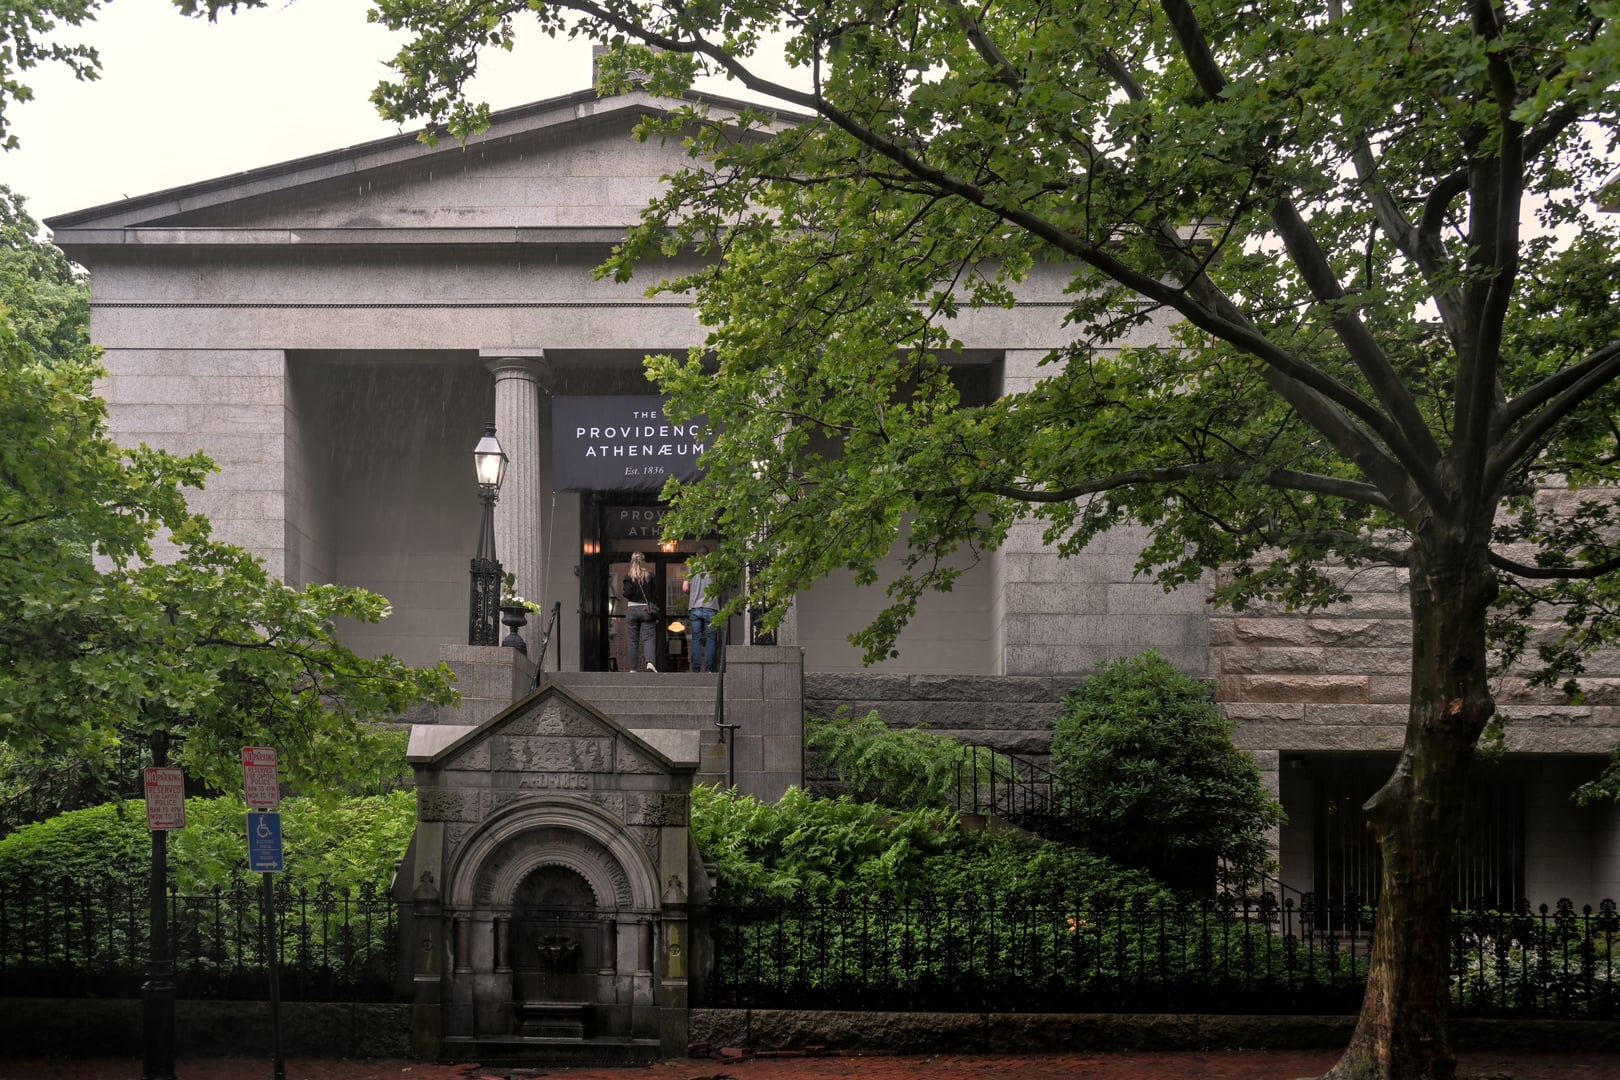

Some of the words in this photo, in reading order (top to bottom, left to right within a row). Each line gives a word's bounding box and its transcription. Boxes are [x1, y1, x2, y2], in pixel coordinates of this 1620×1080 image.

[633, 411, 657, 419] THE
[625, 467, 640, 475] Est.
[643, 466, 665, 475] 1836
[245, 751, 253, 762] NO
[254, 753, 275, 761] PARKING
[147, 772, 157, 783] NO
[158, 774, 181, 782] PARKING
